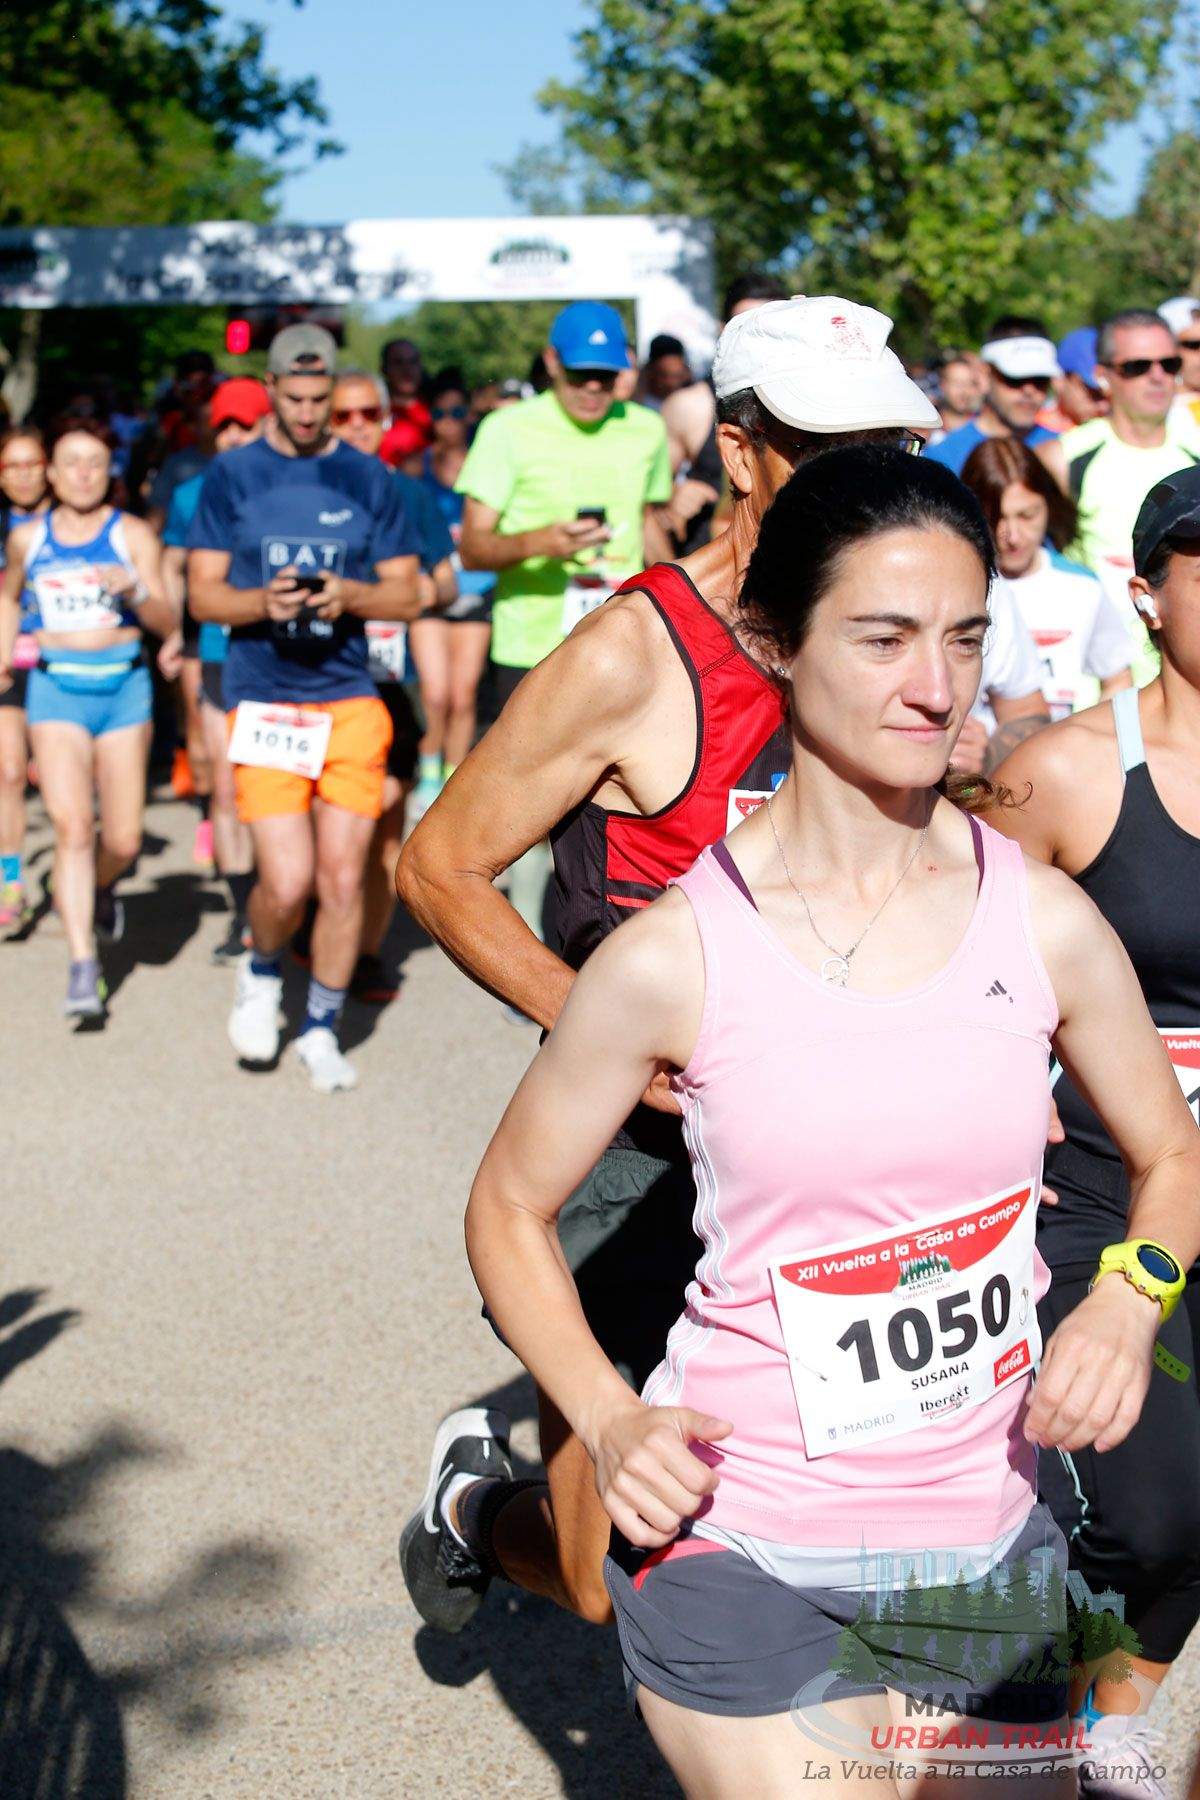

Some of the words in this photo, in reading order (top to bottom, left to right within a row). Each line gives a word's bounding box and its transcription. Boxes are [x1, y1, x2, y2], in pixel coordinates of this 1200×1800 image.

[268, 542, 339, 568] BAT
[254, 729, 310, 753] 1016
[798, 1267, 818, 1282] XII
[823, 1252, 877, 1275] Vuelta
[879, 1249, 891, 1262] a
[894, 1242, 909, 1258] la
[915, 1229, 954, 1250] Casa
[957, 1222, 977, 1237] de
[978, 1201, 1021, 1231] Campo
[836, 1273, 1011, 1383] 1050
[911, 1361, 969, 1391] SUSANA
[920, 1385, 970, 1412] Iberext
[844, 1413, 895, 1435] MADRID
